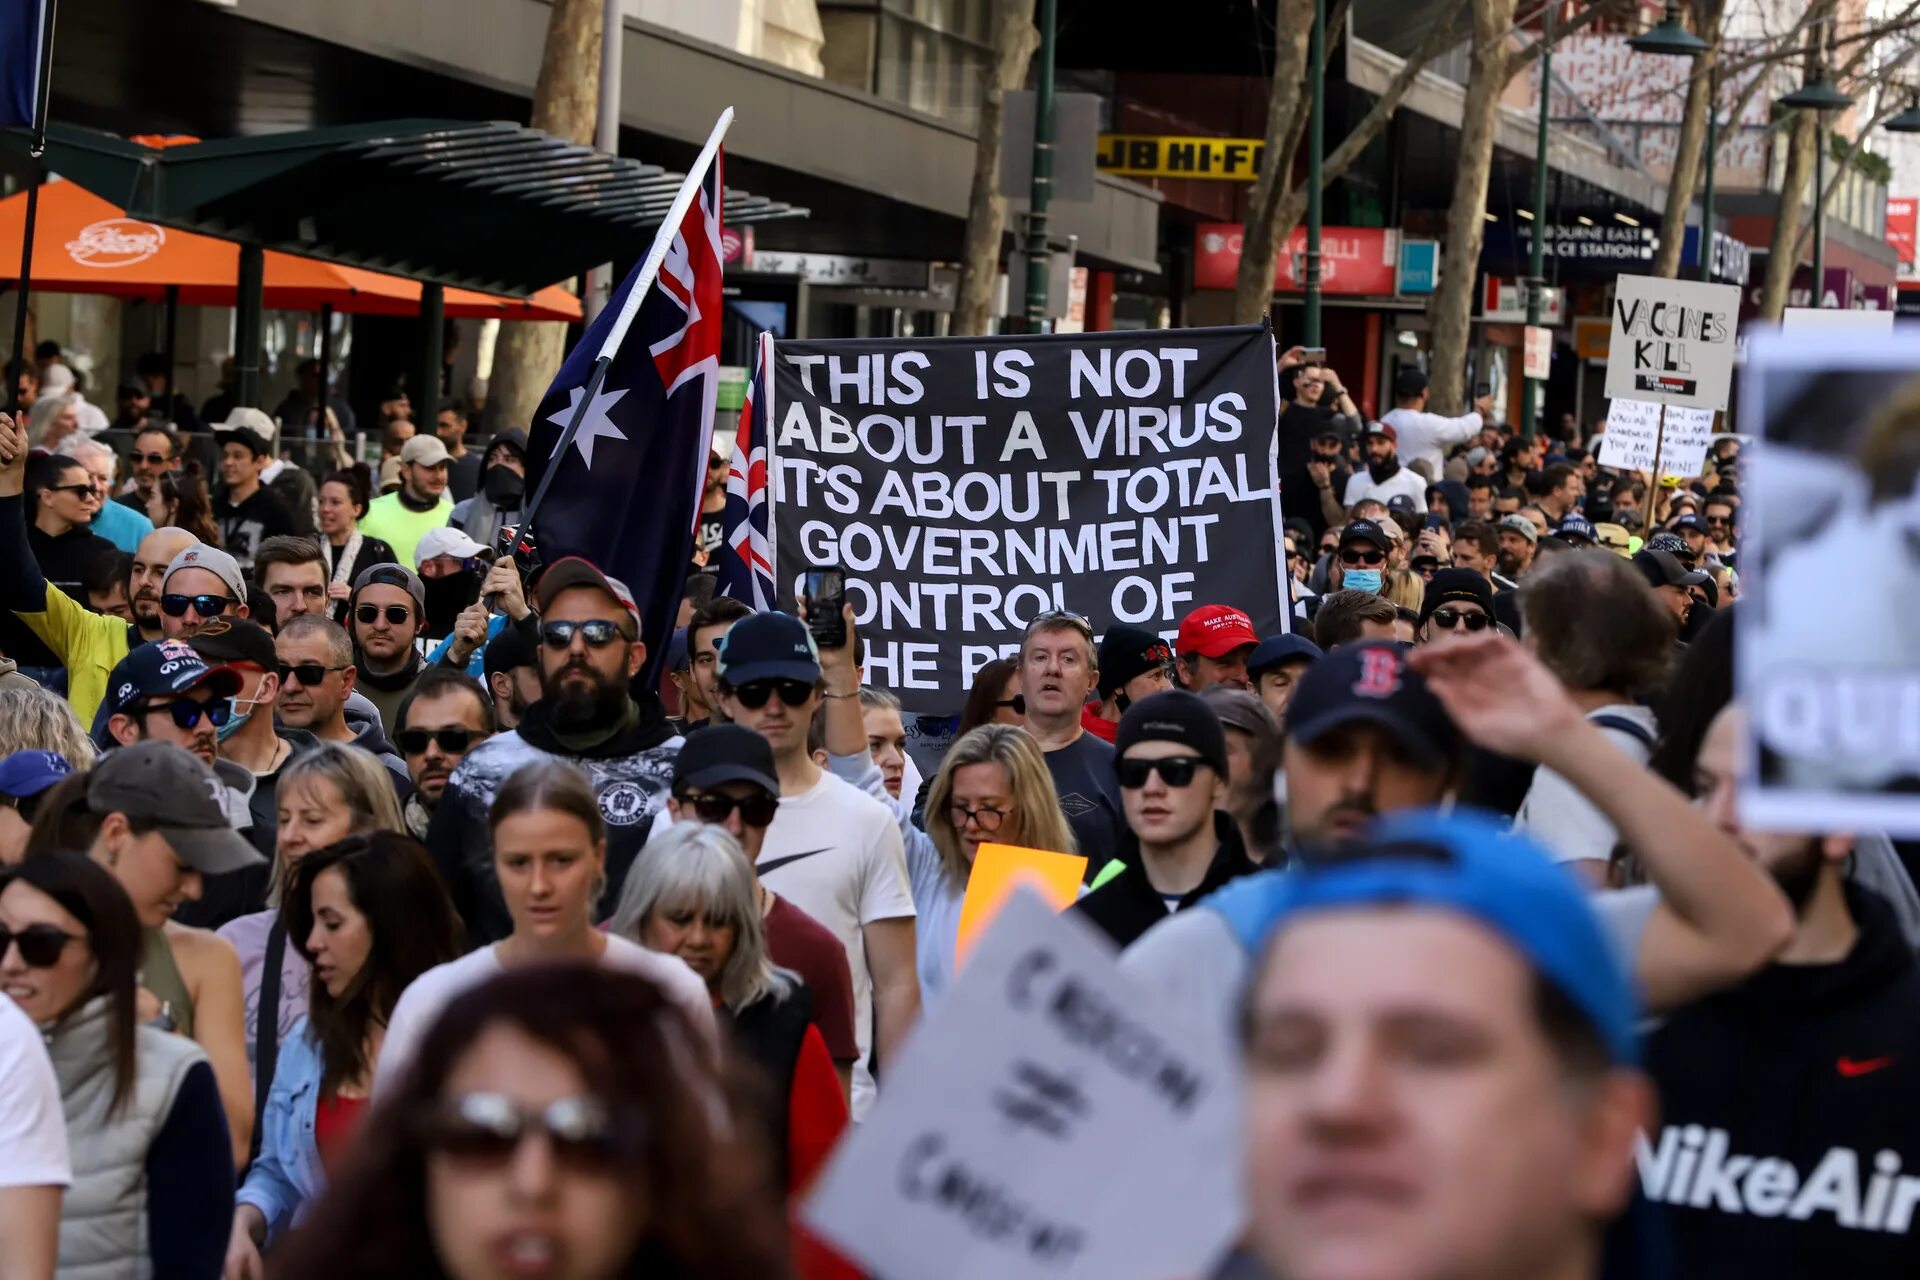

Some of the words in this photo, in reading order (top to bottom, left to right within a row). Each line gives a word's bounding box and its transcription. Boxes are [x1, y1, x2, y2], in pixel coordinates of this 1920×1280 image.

[1097, 139, 1157, 169] JB
[1517, 224, 1603, 242] MBOURNE
[1580, 241, 1640, 259] STATION
[1616, 298, 1728, 343] VACCINES
[785, 349, 931, 405] THIS
[975, 349, 1035, 400] IS
[1070, 347, 1198, 399] NOT
[1634, 340, 1691, 373] KILL
[777, 401, 987, 465] ABOUT
[999, 410, 1048, 462] A
[1069, 392, 1247, 459] VIRUS
[1623, 453, 1692, 473] EXPERMENT
[775, 455, 863, 514] IT'S
[868, 470, 1081, 522] ABOUT
[1094, 453, 1272, 512] TOTAL
[800, 513, 1220, 576] GOVERNMENT
[1110, 571, 1195, 623] OF
[1203, 616, 1223, 627] MAKE
[863, 637, 940, 689] HE
